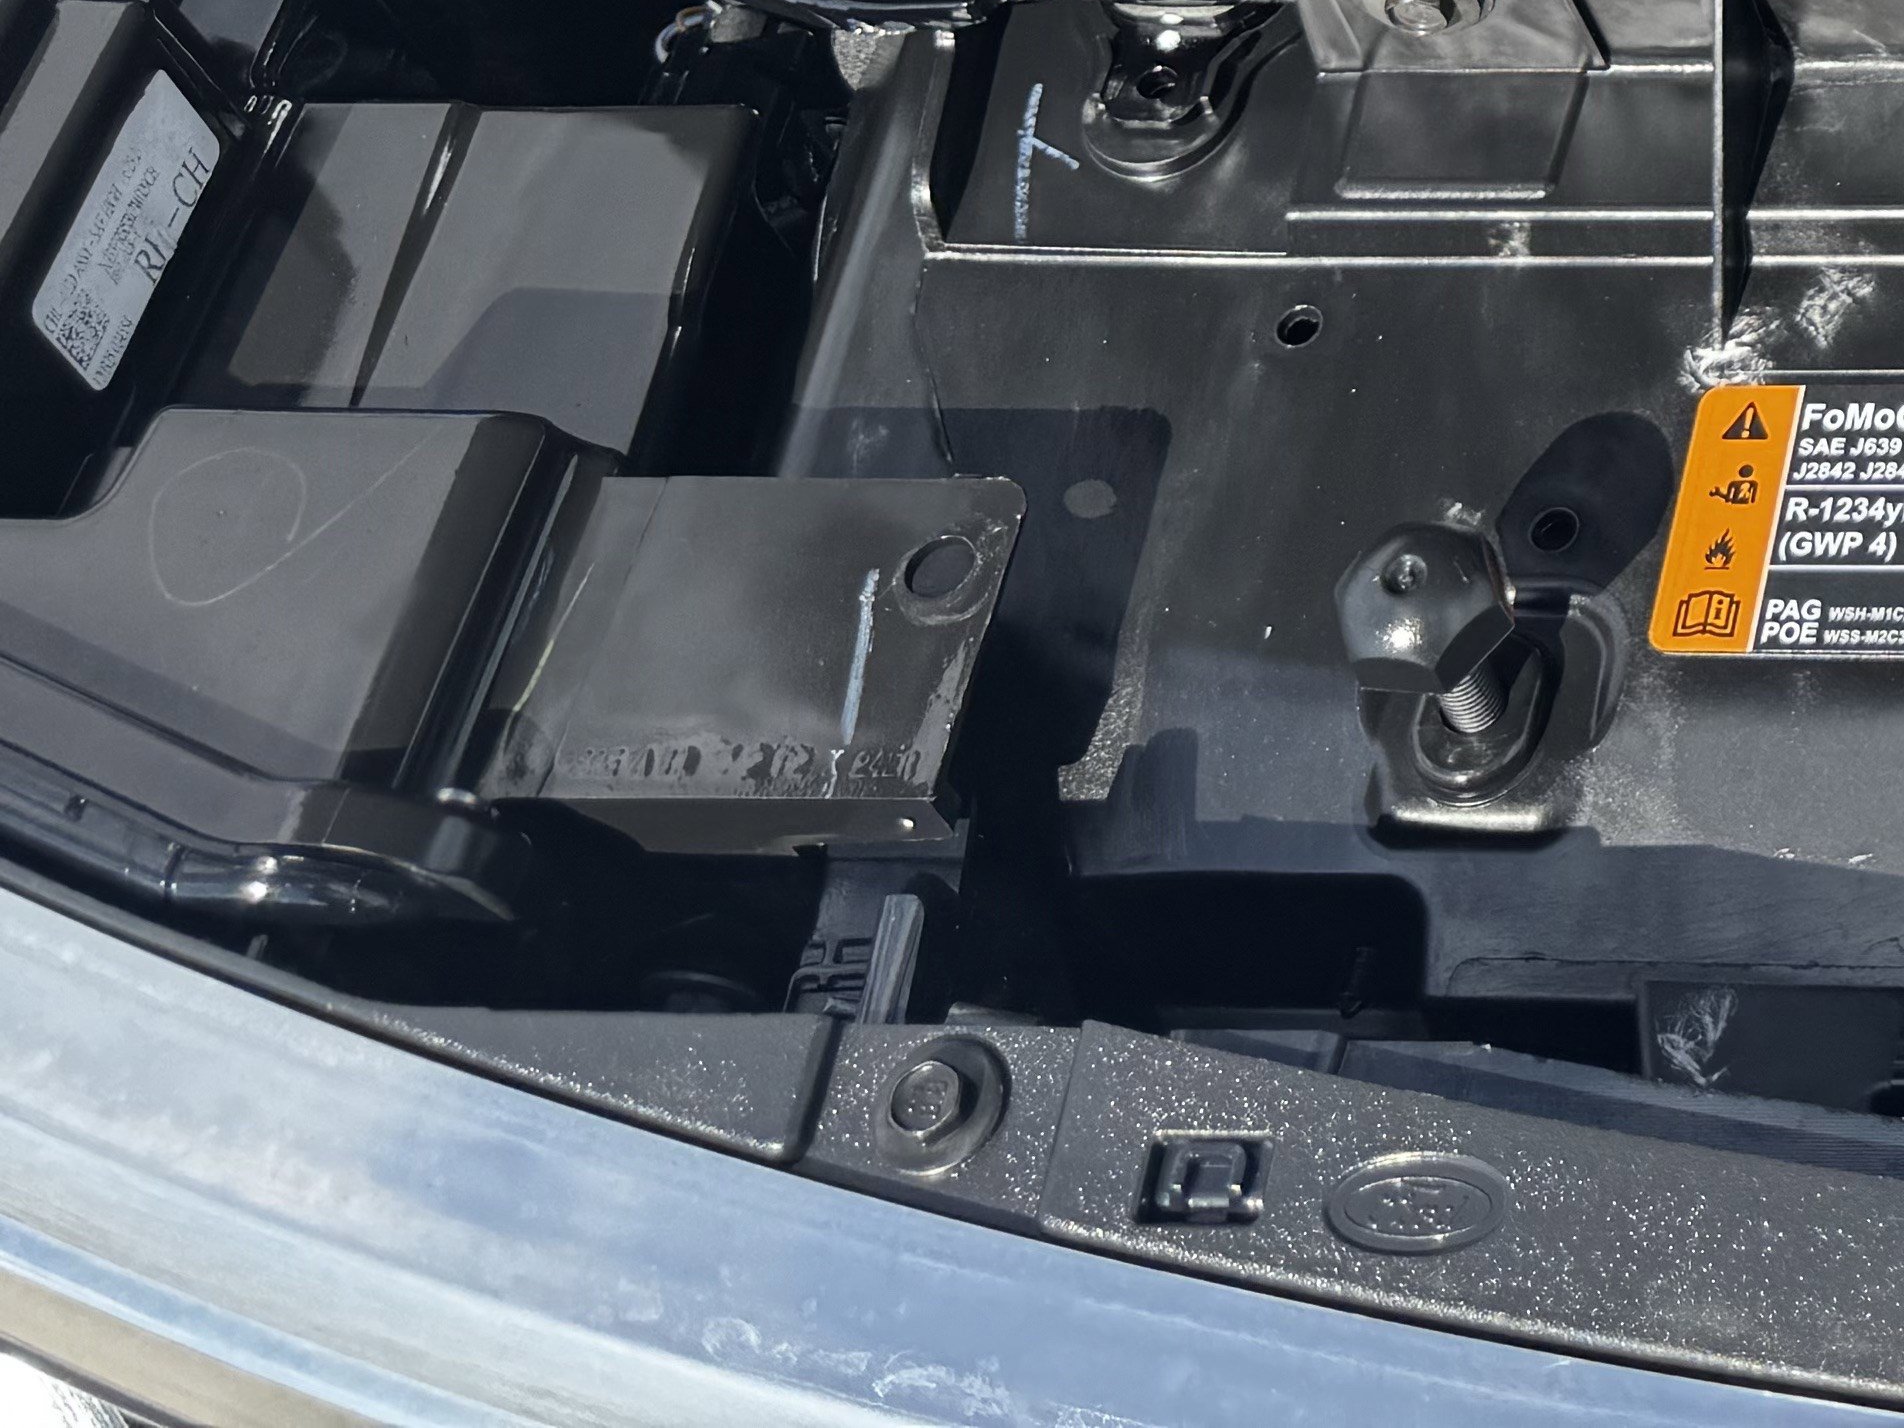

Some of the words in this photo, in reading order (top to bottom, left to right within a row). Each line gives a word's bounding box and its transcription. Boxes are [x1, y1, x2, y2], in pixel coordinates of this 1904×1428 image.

[1798, 438, 1846, 455] SAE
[1849, 438, 1903, 455] J639
[1793, 462, 1856, 480] J2842
[1778, 531, 1863, 562] (GWP
[1867, 531, 1898, 562] 4)
[1765, 599, 1822, 620] PAG
[1760, 622, 1819, 644] POE
